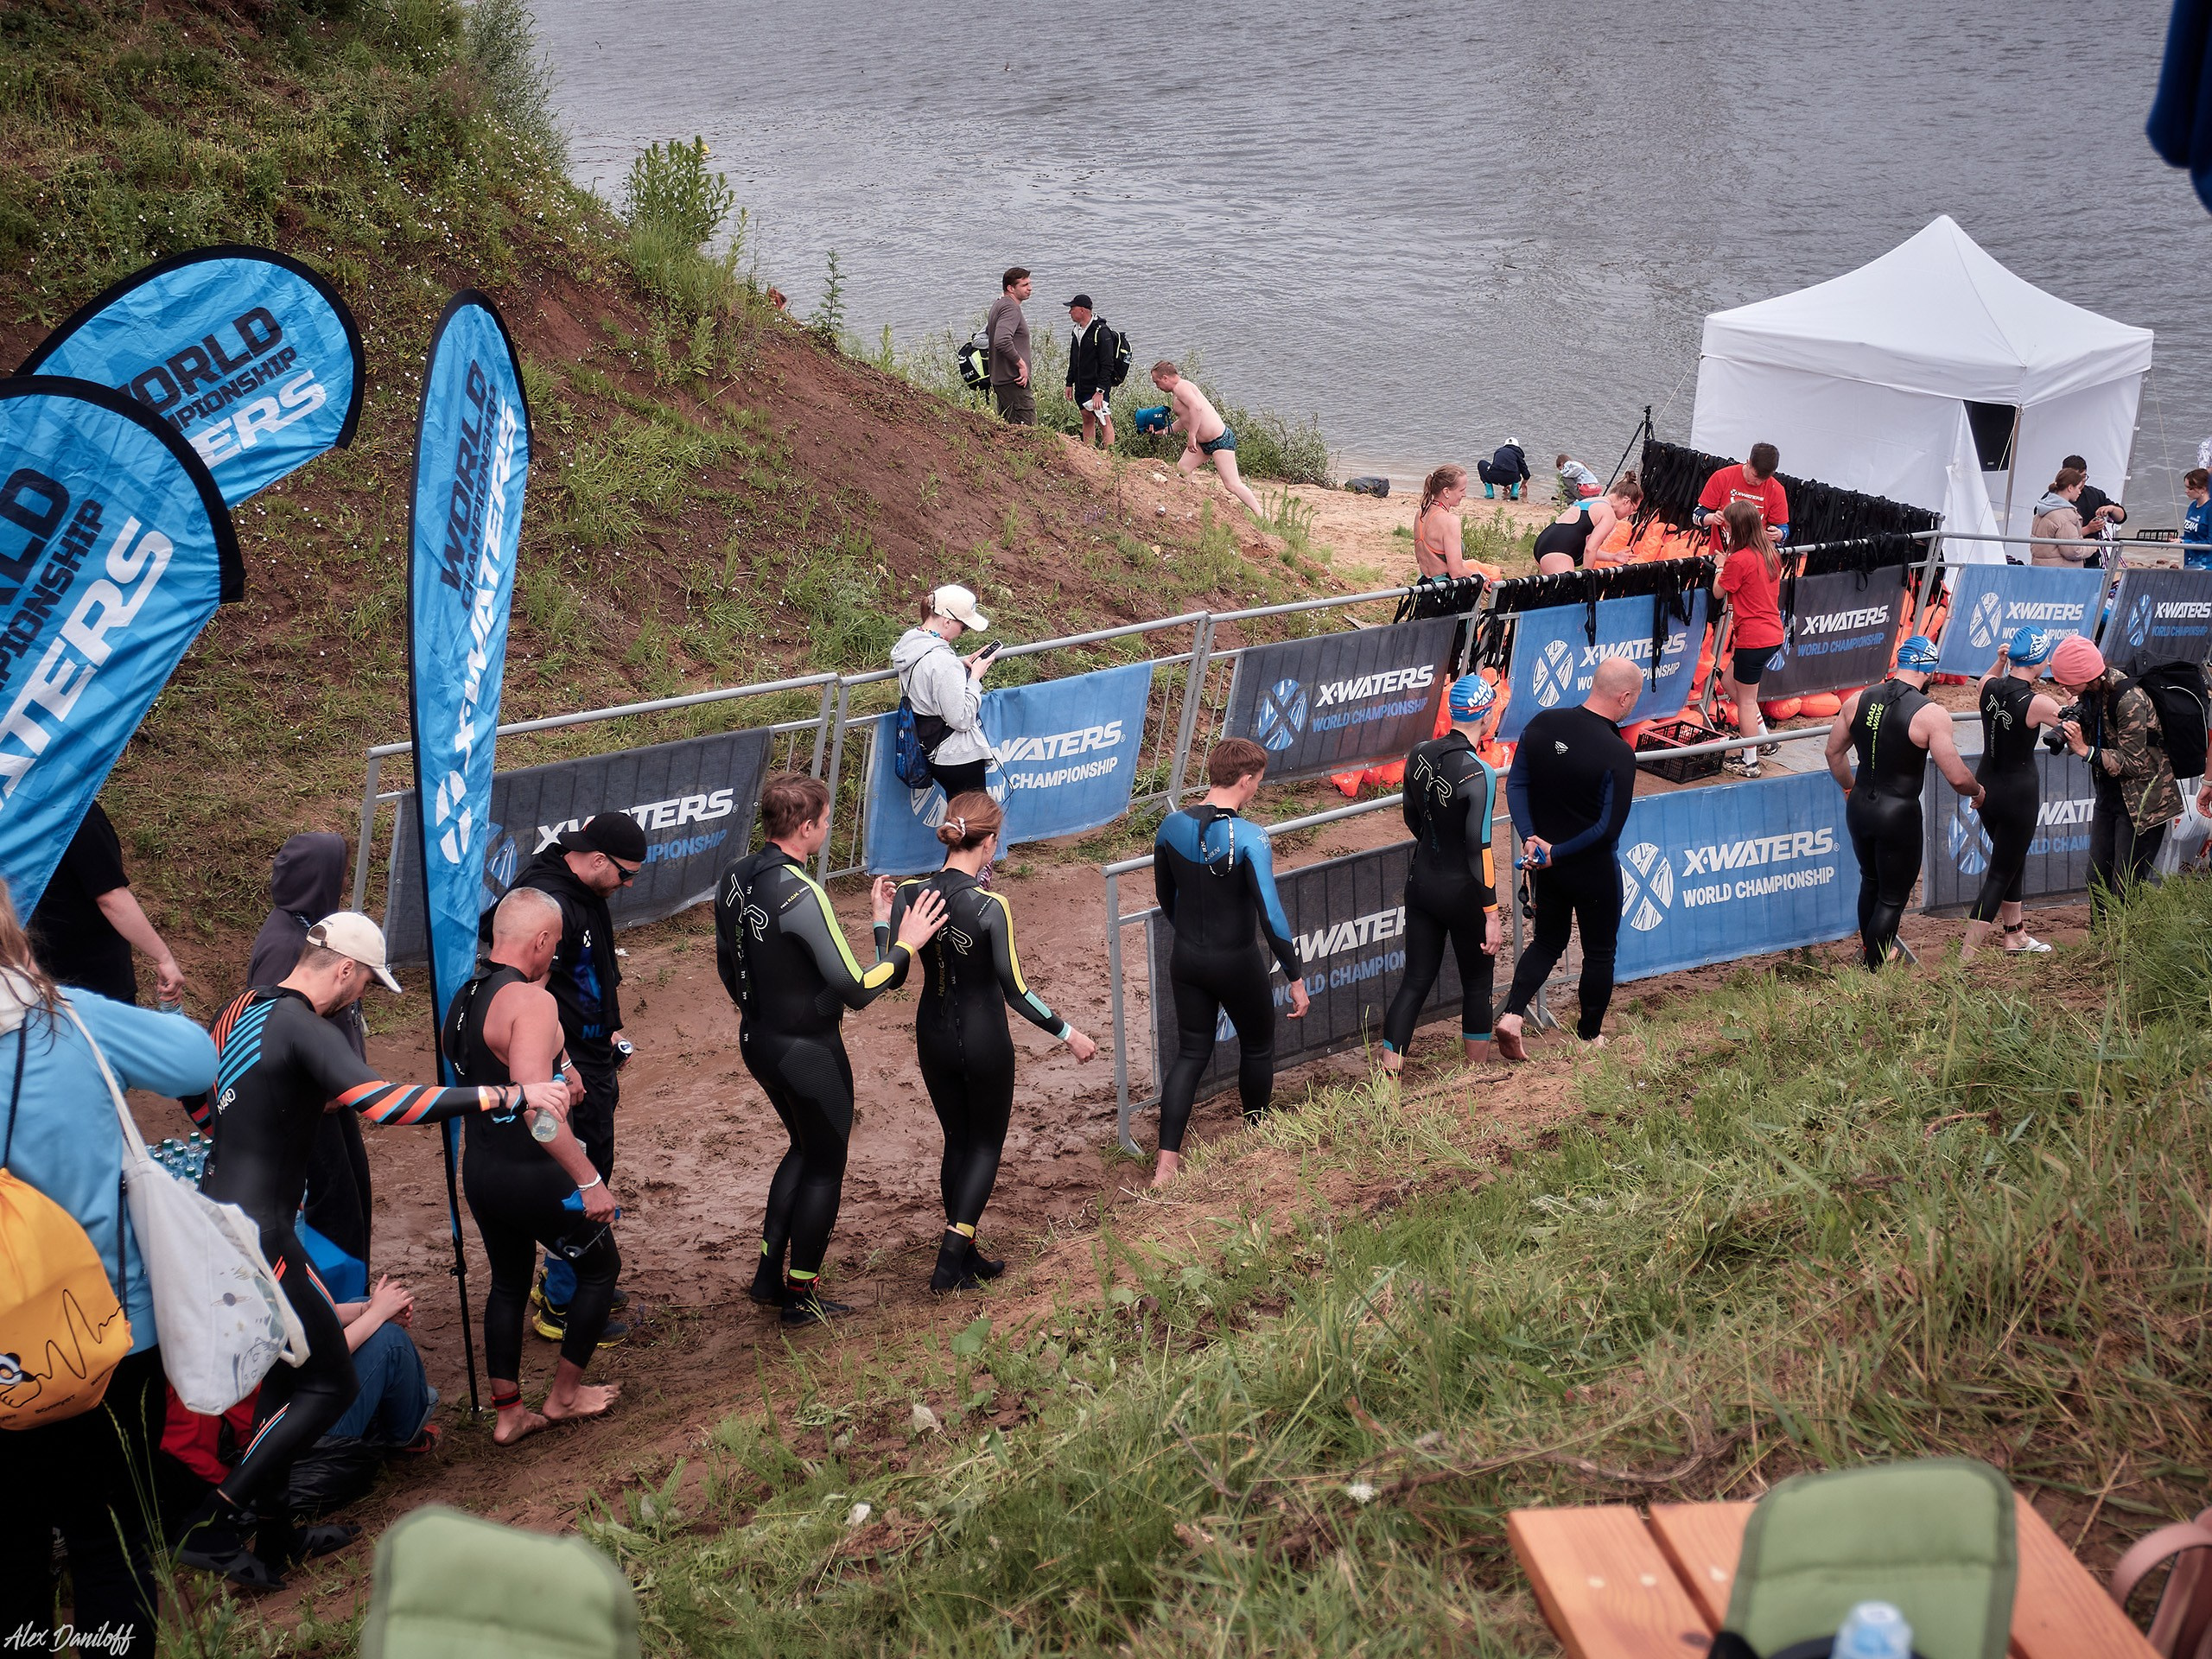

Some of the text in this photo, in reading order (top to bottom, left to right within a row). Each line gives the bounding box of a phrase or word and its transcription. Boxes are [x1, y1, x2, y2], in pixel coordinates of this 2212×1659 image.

[116, 307, 283, 413] ORLD
[167, 346, 297, 432] PIONSHIP
[440, 359, 487, 592] WORLD
[0, 499, 105, 690] PIONSHIP
[1797, 632, 1885, 657] WORLD CHAMPIONSHIP
[1466, 678, 1487, 708] MAD
[1313, 696, 1428, 733] WORLD CHAMPIONSHIP
[1866, 702, 1878, 727] MAD
[1872, 702, 1885, 730] WAVE
[1986, 694, 2013, 731] TYR
[1009, 756, 1118, 790] CHAMPIONSHIP
[1414, 753, 1452, 808] TYR
[642, 829, 728, 864] PIONSHIP
[1682, 866, 1834, 908] WORLD CHAMPIONSHIP
[1272, 950, 1406, 1007] WOLD CHAMPION
